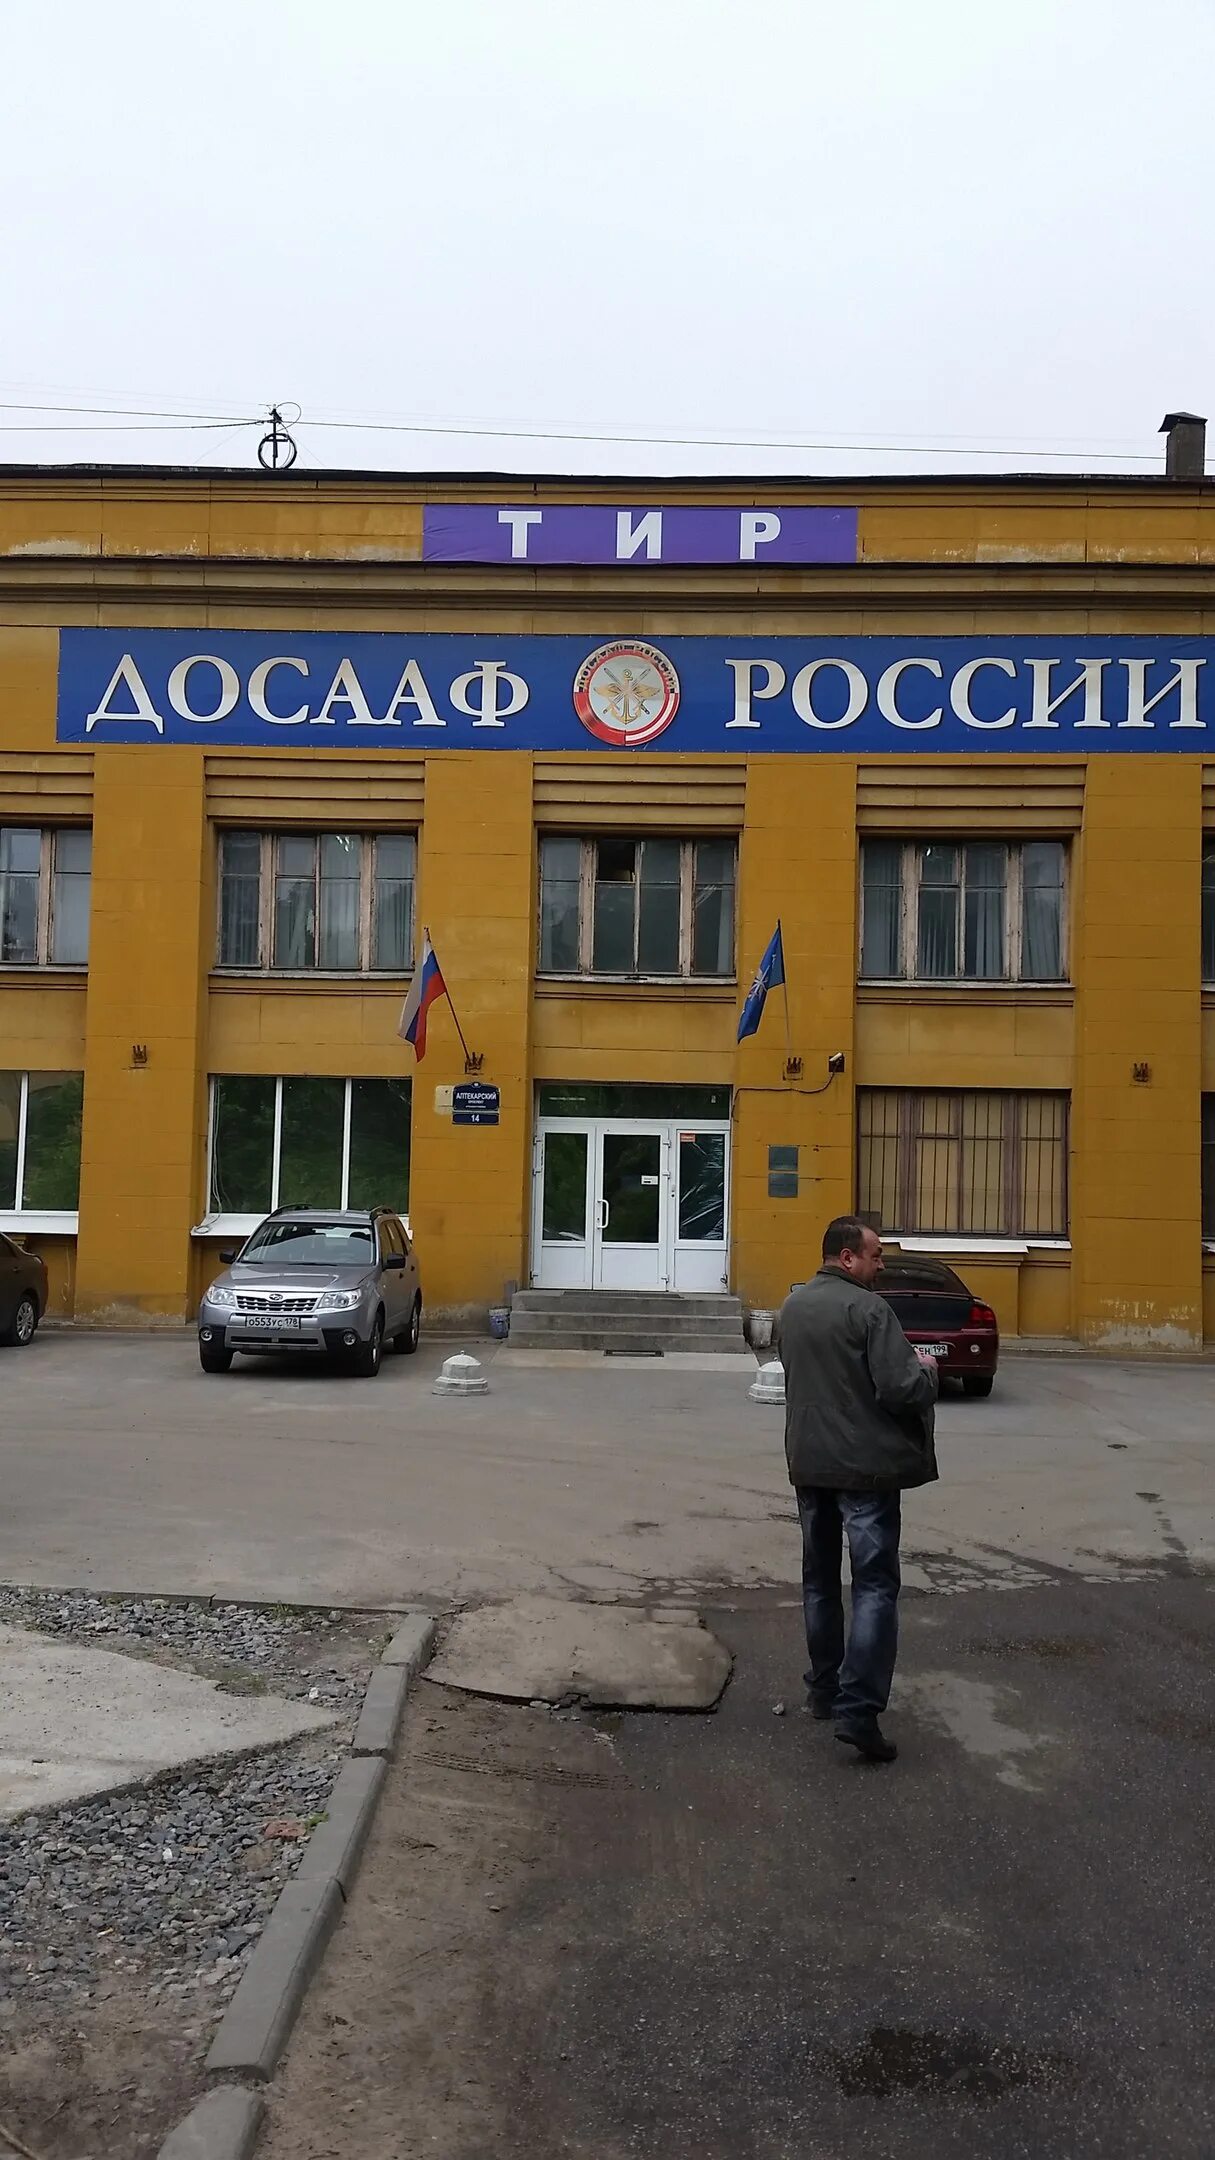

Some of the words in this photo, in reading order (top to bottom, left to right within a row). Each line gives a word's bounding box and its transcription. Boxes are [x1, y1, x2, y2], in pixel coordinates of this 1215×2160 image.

[498, 510, 781, 560] ТИР
[85, 653, 530, 734] ДОСААФ
[724, 657, 1207, 728] РОССИИ
[455, 1092, 497, 1100] АПТЕКАРСКИЙ
[471, 1114, 480, 1122] 14
[284, 1317, 298, 1325] 178
[932, 1345, 946, 1353] 199
